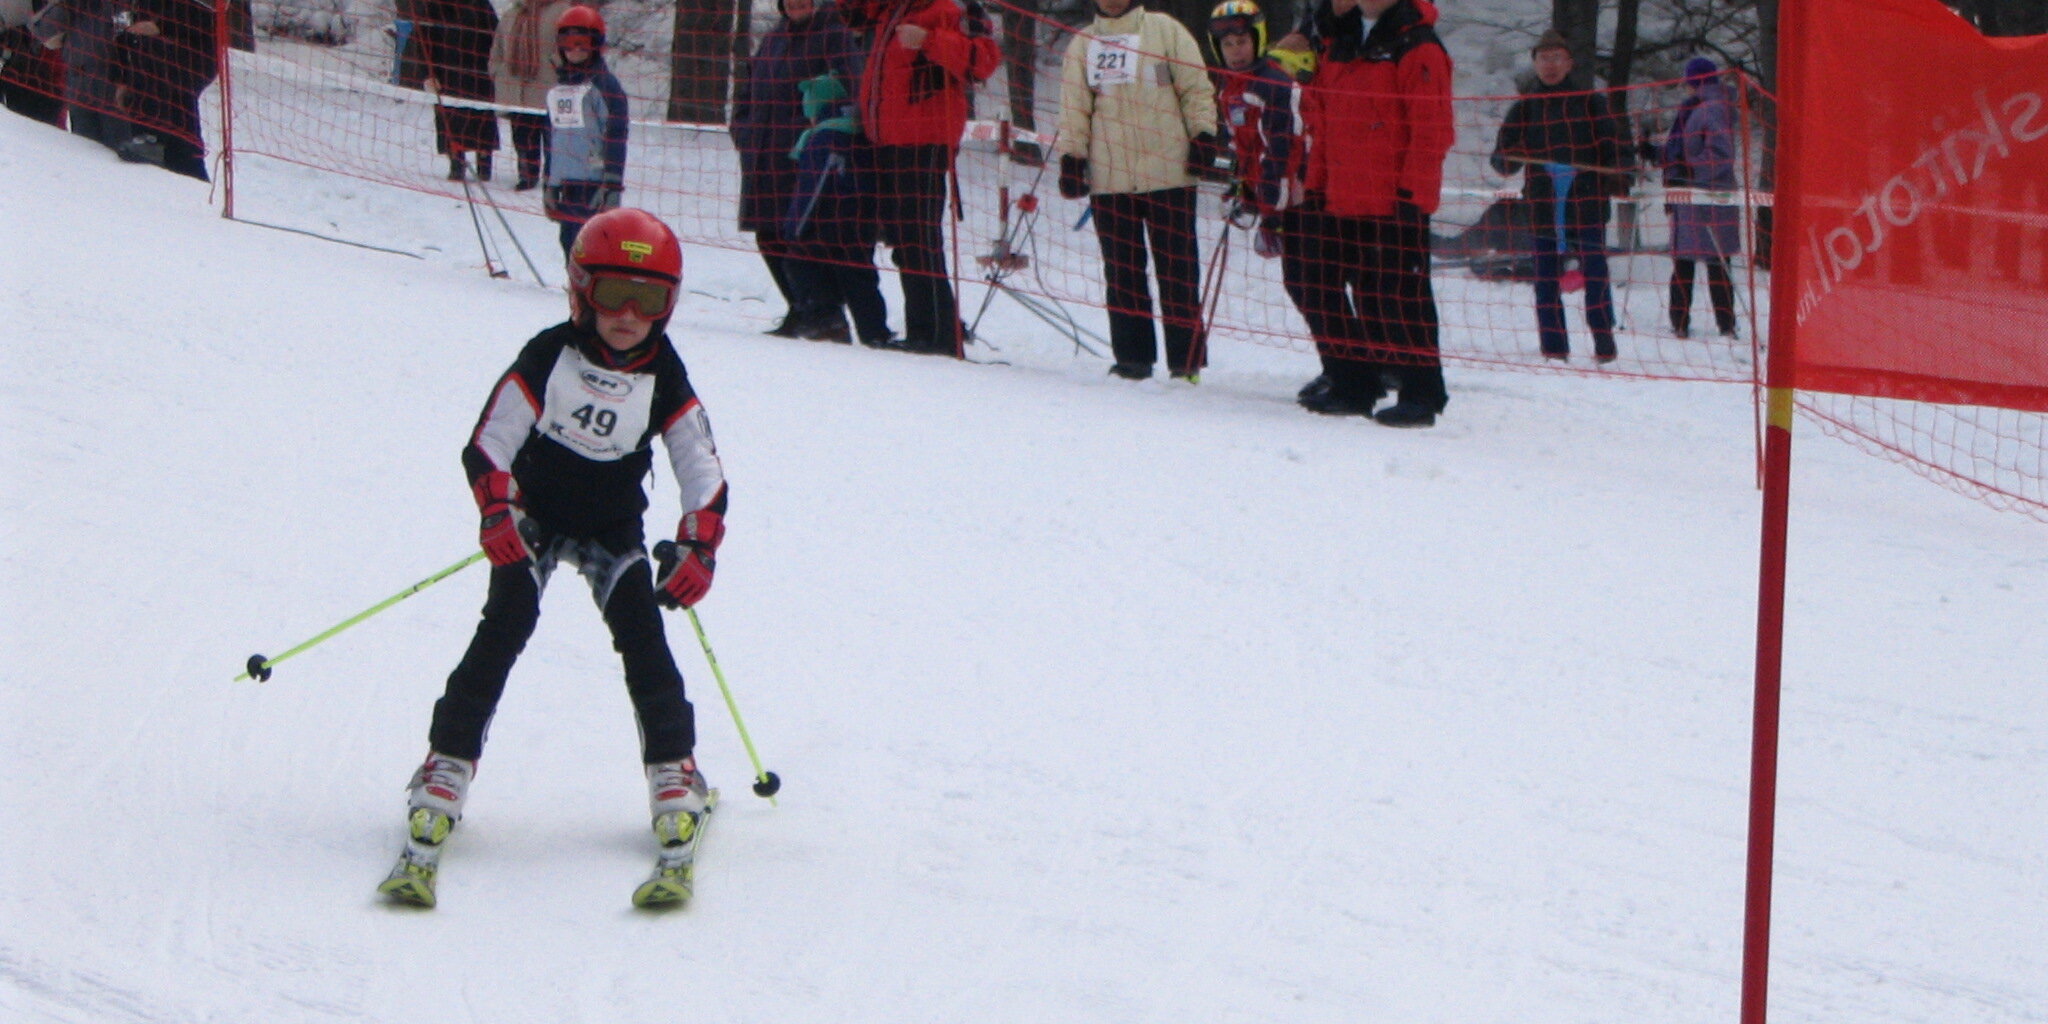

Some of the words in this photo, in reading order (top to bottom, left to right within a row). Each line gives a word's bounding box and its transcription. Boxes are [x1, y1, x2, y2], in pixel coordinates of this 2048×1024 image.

[1097, 53, 1126, 69] 221
[557, 98, 572, 114] 99
[571, 404, 618, 437] 49
